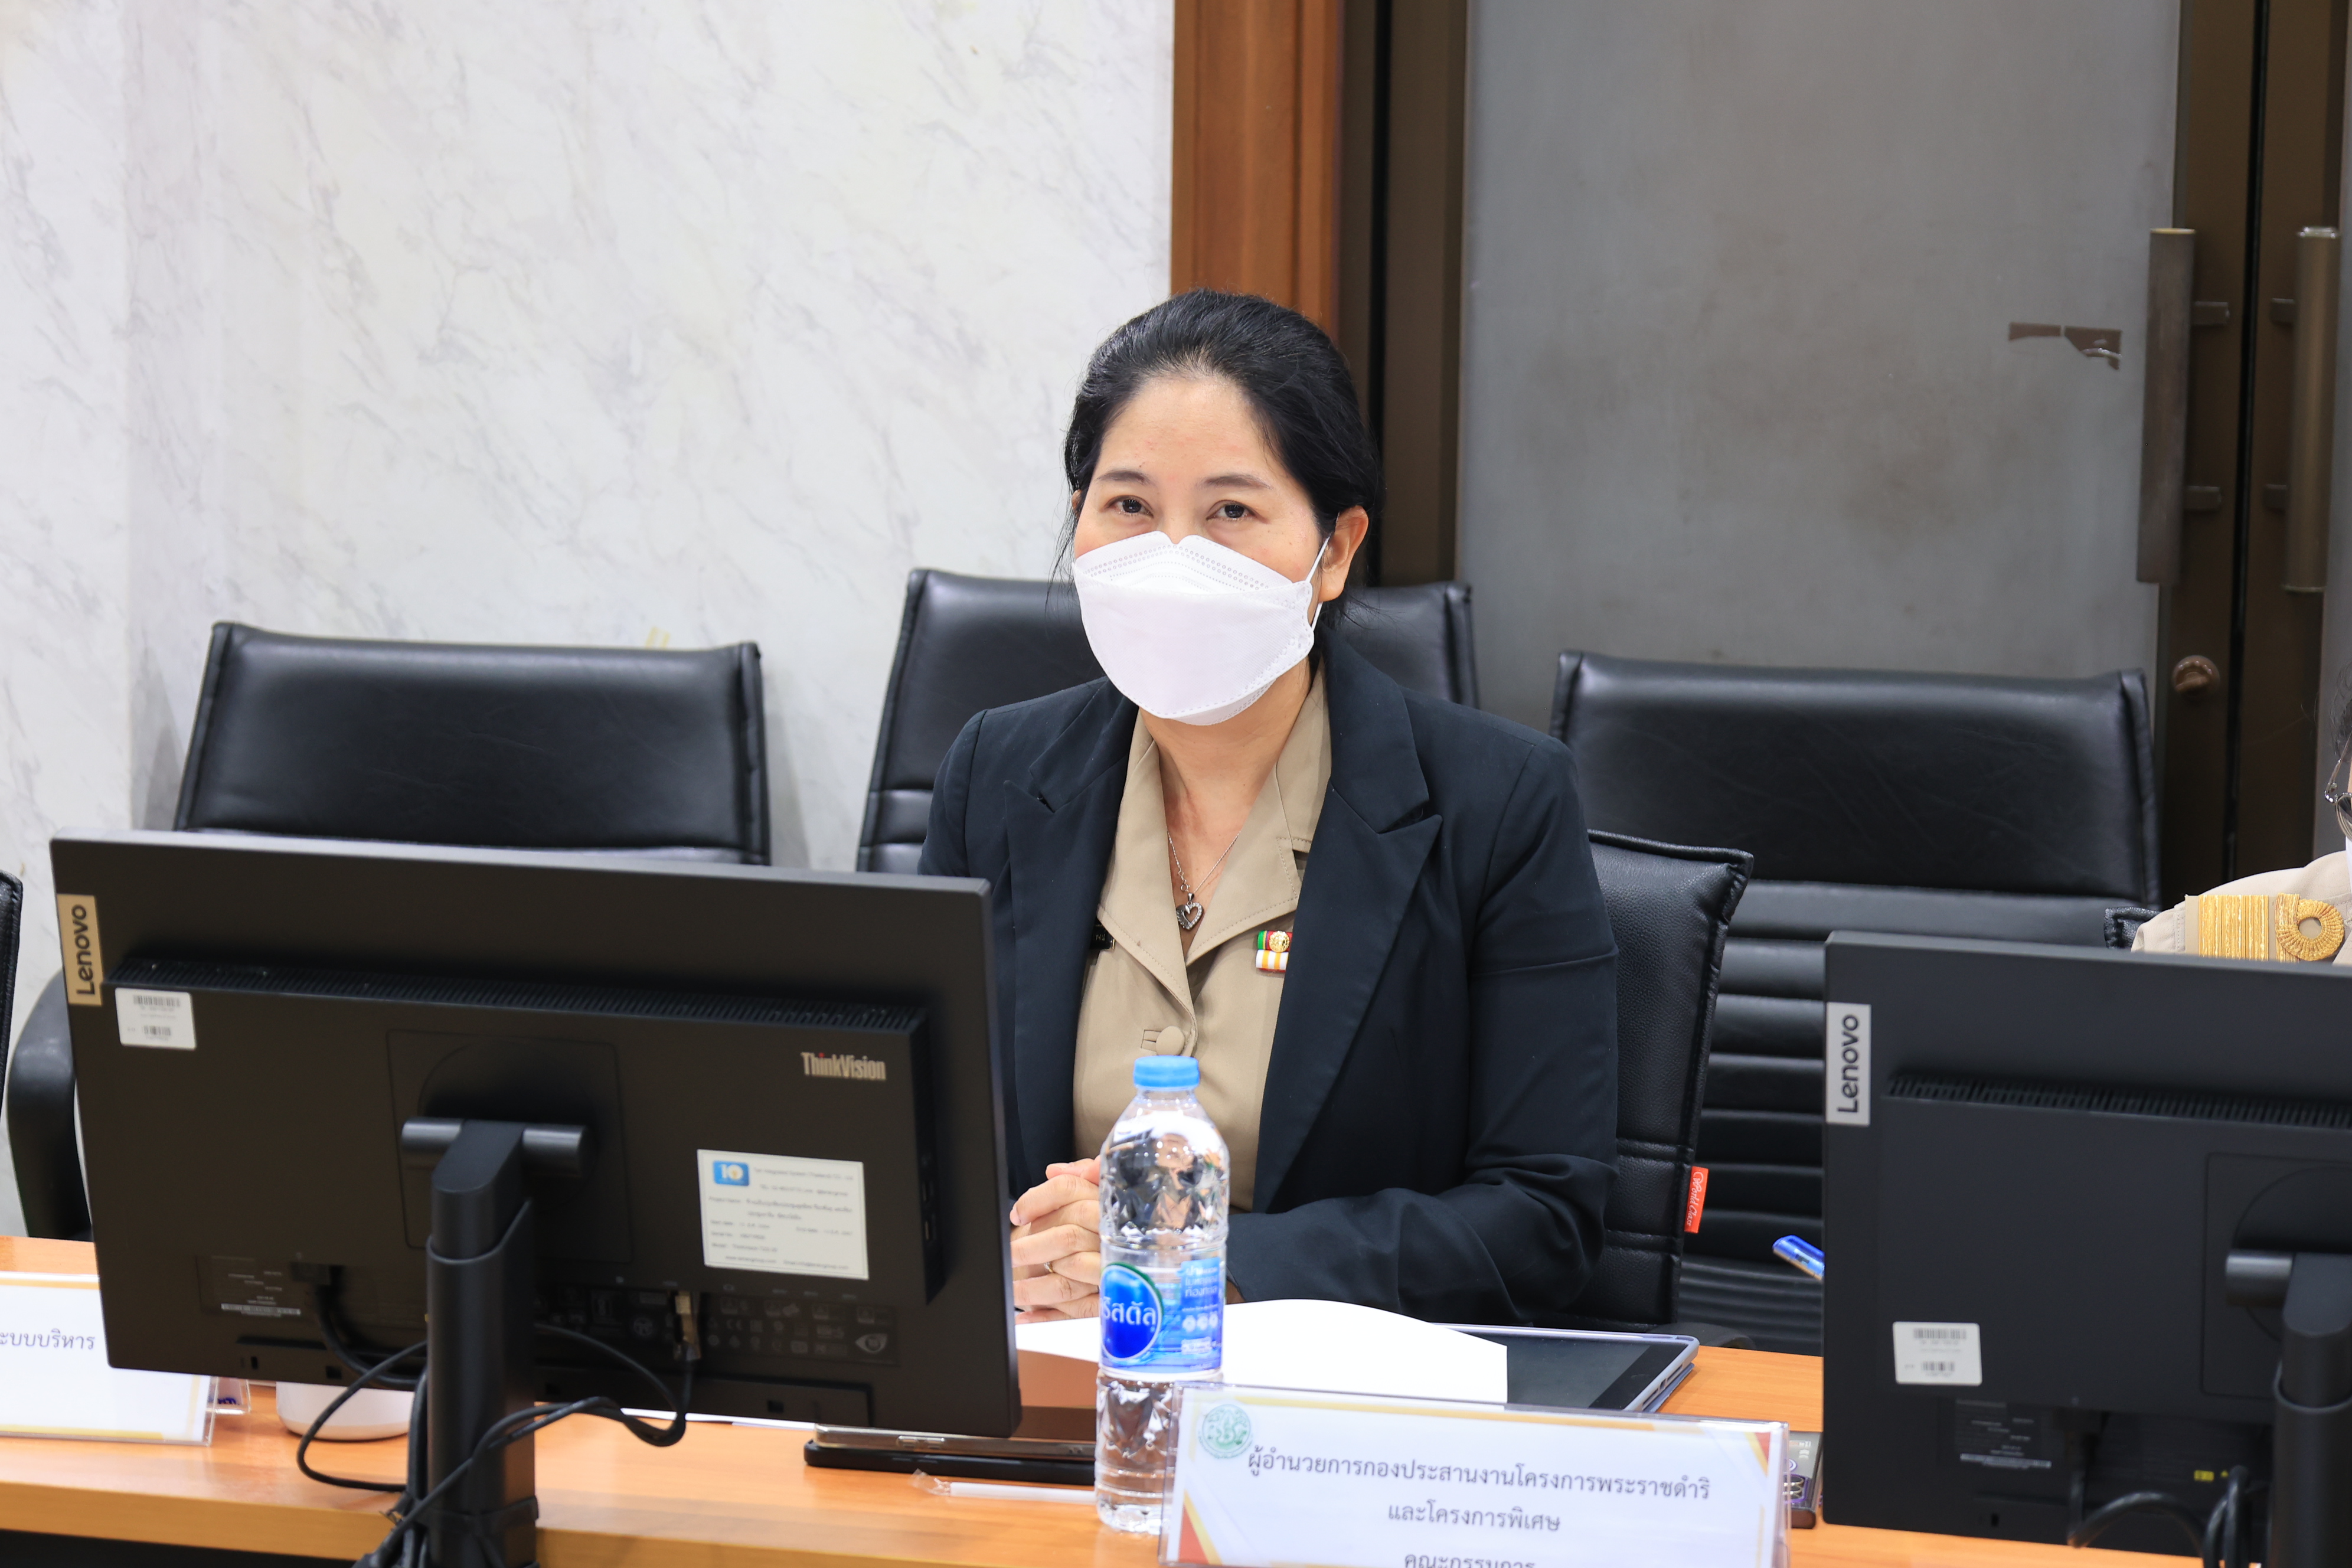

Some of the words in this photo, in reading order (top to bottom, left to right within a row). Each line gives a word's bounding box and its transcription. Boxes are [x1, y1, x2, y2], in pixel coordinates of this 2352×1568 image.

[71, 904, 95, 995] Lenovo
[801, 1052, 886, 1080] ThinkVision
[1837, 1014, 1858, 1113] Lenovo
[1690, 1171, 1704, 1205] World
[1687, 1205, 1697, 1226] Class
[1248, 1445, 1710, 1500] ผู้อำนวยการกองประสานงานโครงการพระราชดำริ
[1389, 1499, 1560, 1531] และโครงการพิเศษ
